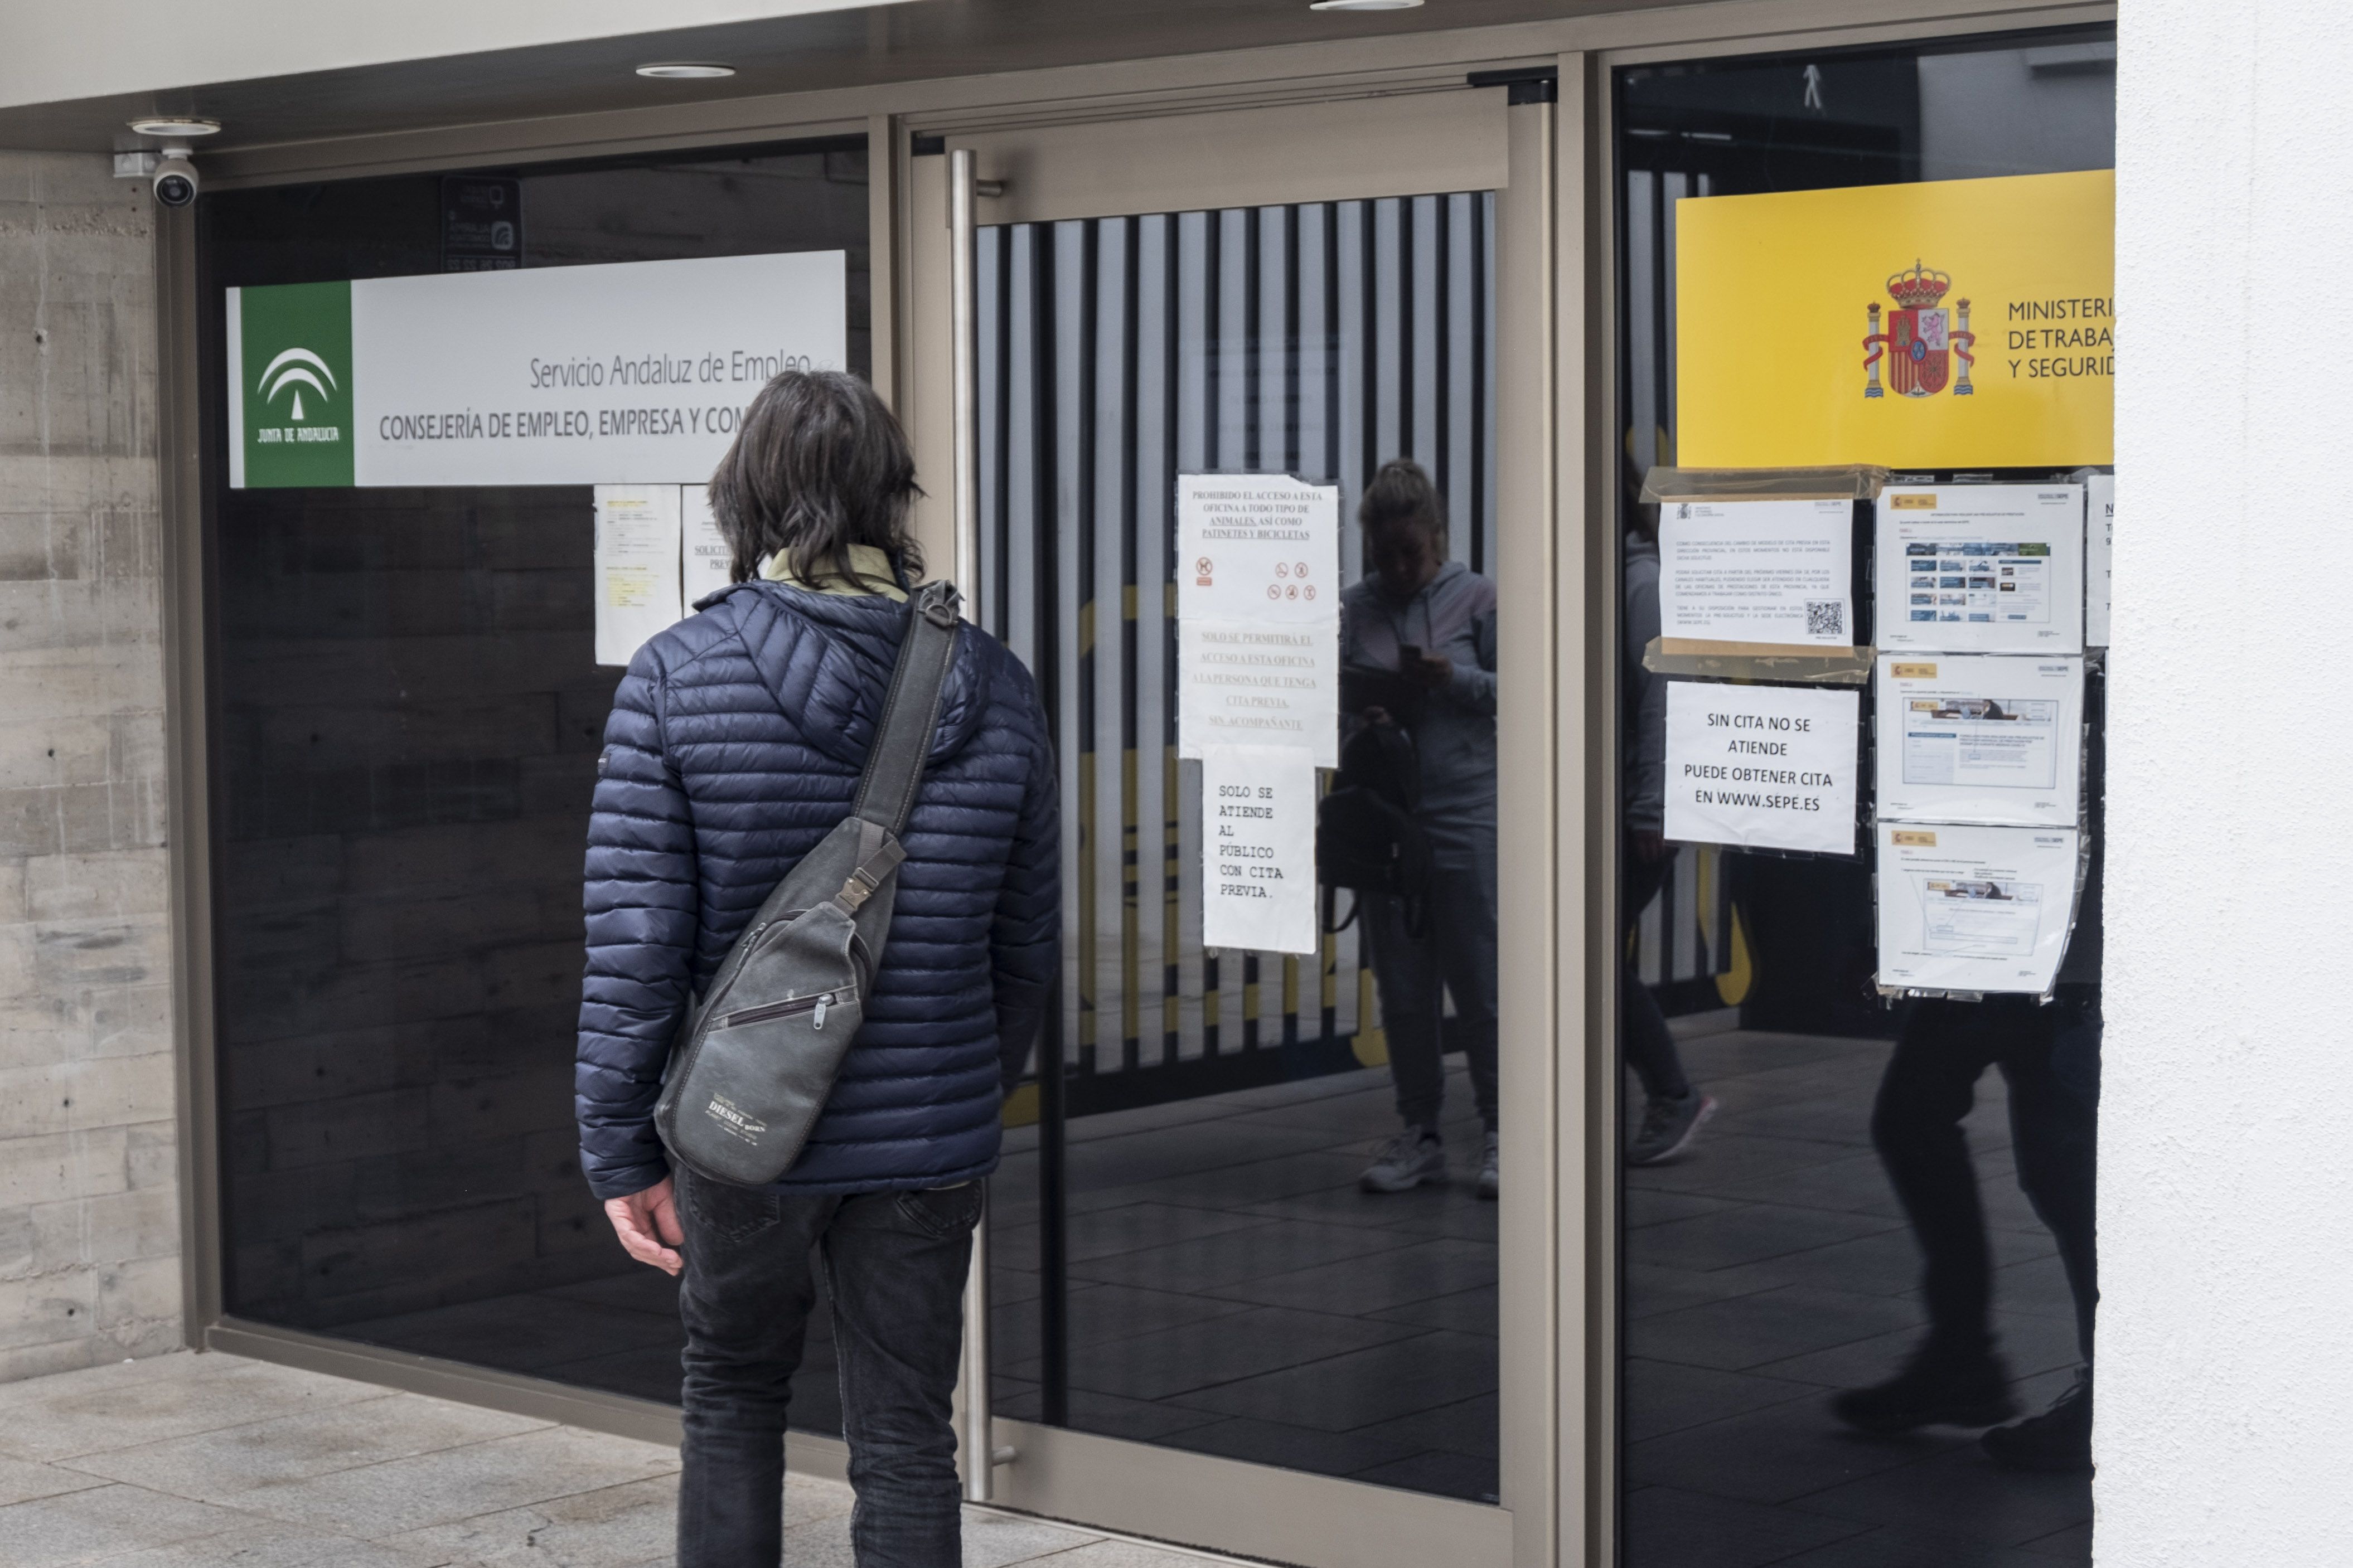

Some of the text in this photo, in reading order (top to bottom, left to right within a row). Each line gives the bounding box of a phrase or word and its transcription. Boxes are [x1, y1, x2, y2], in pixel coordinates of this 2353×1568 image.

[2009, 327, 2114, 352] DE TRABA
[530, 356, 604, 388] Servicio
[609, 352, 691, 385] Andaluz
[699, 352, 724, 382] de
[2008, 359, 2021, 378] Y
[380, 406, 483, 440] CONSEJERÍA
[488, 412, 511, 437] DE
[517, 410, 593, 440] EMPLEO,
[600, 407, 684, 435] EMPRESA
[689, 407, 700, 434] Y
[258, 428, 282, 443] JUNTA
[284, 428, 294, 442] DE
[1193, 491, 1322, 501] PROHIBIDO EL ACCESO A ESTA
[1203, 504, 1309, 513] OFICINA A TODO TIPO DE
[1258, 514, 1273, 525] ASÍ
[1275, 517, 1302, 526] COMO
[1202, 529, 1310, 540] PATINETES Y BICICLETAS
[1201, 632, 1227, 642] SOLO
[1228, 633, 1241, 642] SE
[1300, 635, 1313, 645] EL
[1200, 653, 1315, 666] ACCESO A ESTA OFICINA
[1193, 673, 1316, 688] A LA PERSONA QUE TENGA
[1226, 695, 1249, 706] CITA
[1707, 713, 1810, 732] SIN CITA NO SE
[1728, 740, 1788, 756] ATIENDE
[1684, 764, 1833, 787] PUEDE OBTENER CITA
[1219, 785, 1273, 798] SOLO SE
[1696, 790, 1820, 810] EN WWW.SEPE.ES
[1219, 805, 1273, 818] ATIENDE
[1219, 826, 1234, 836] AL
[1219, 842, 1274, 858] PÚBLICO
[1220, 865, 1284, 879] CON CITA
[1221, 884, 1273, 898] PREVIA.
[708, 1101, 744, 1127] DIESEL
